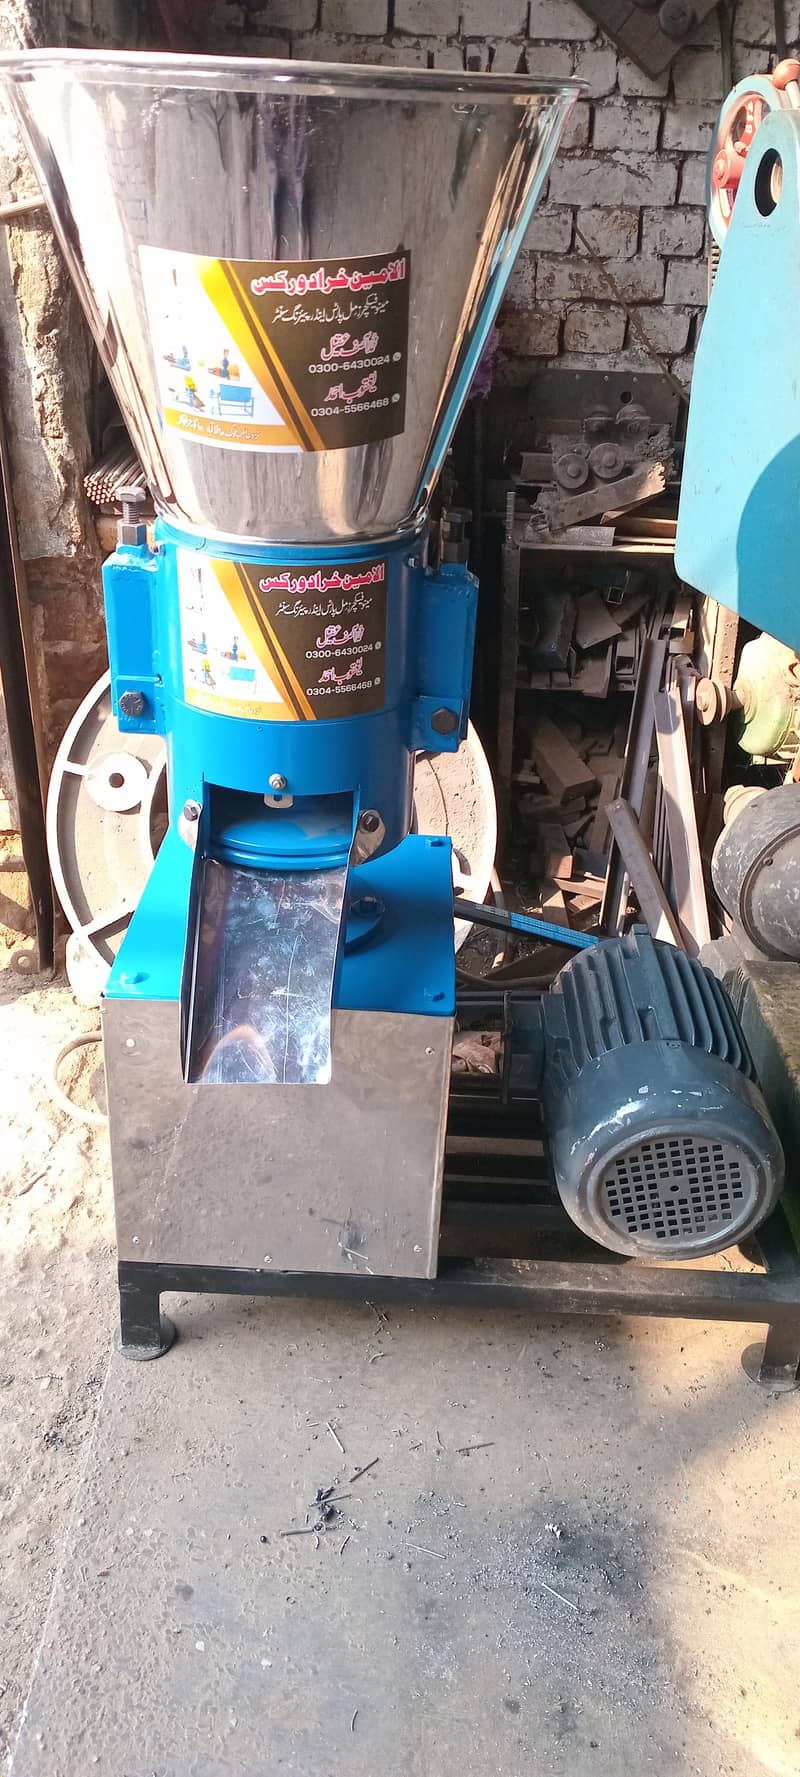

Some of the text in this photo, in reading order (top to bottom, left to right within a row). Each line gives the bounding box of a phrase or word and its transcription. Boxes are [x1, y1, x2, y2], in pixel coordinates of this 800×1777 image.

[251, 270, 308, 296] ورکس
[308, 267, 350, 294] خراد
[308, 355, 390, 374] 0300-6430024
[311, 398, 389, 416] 0304-5566468
[260, 572, 308, 594] ورکس
[308, 570, 342, 592] خراد
[305, 644, 373, 659] 0300-6430024
[306, 680, 372, 696] 0304-5566468
